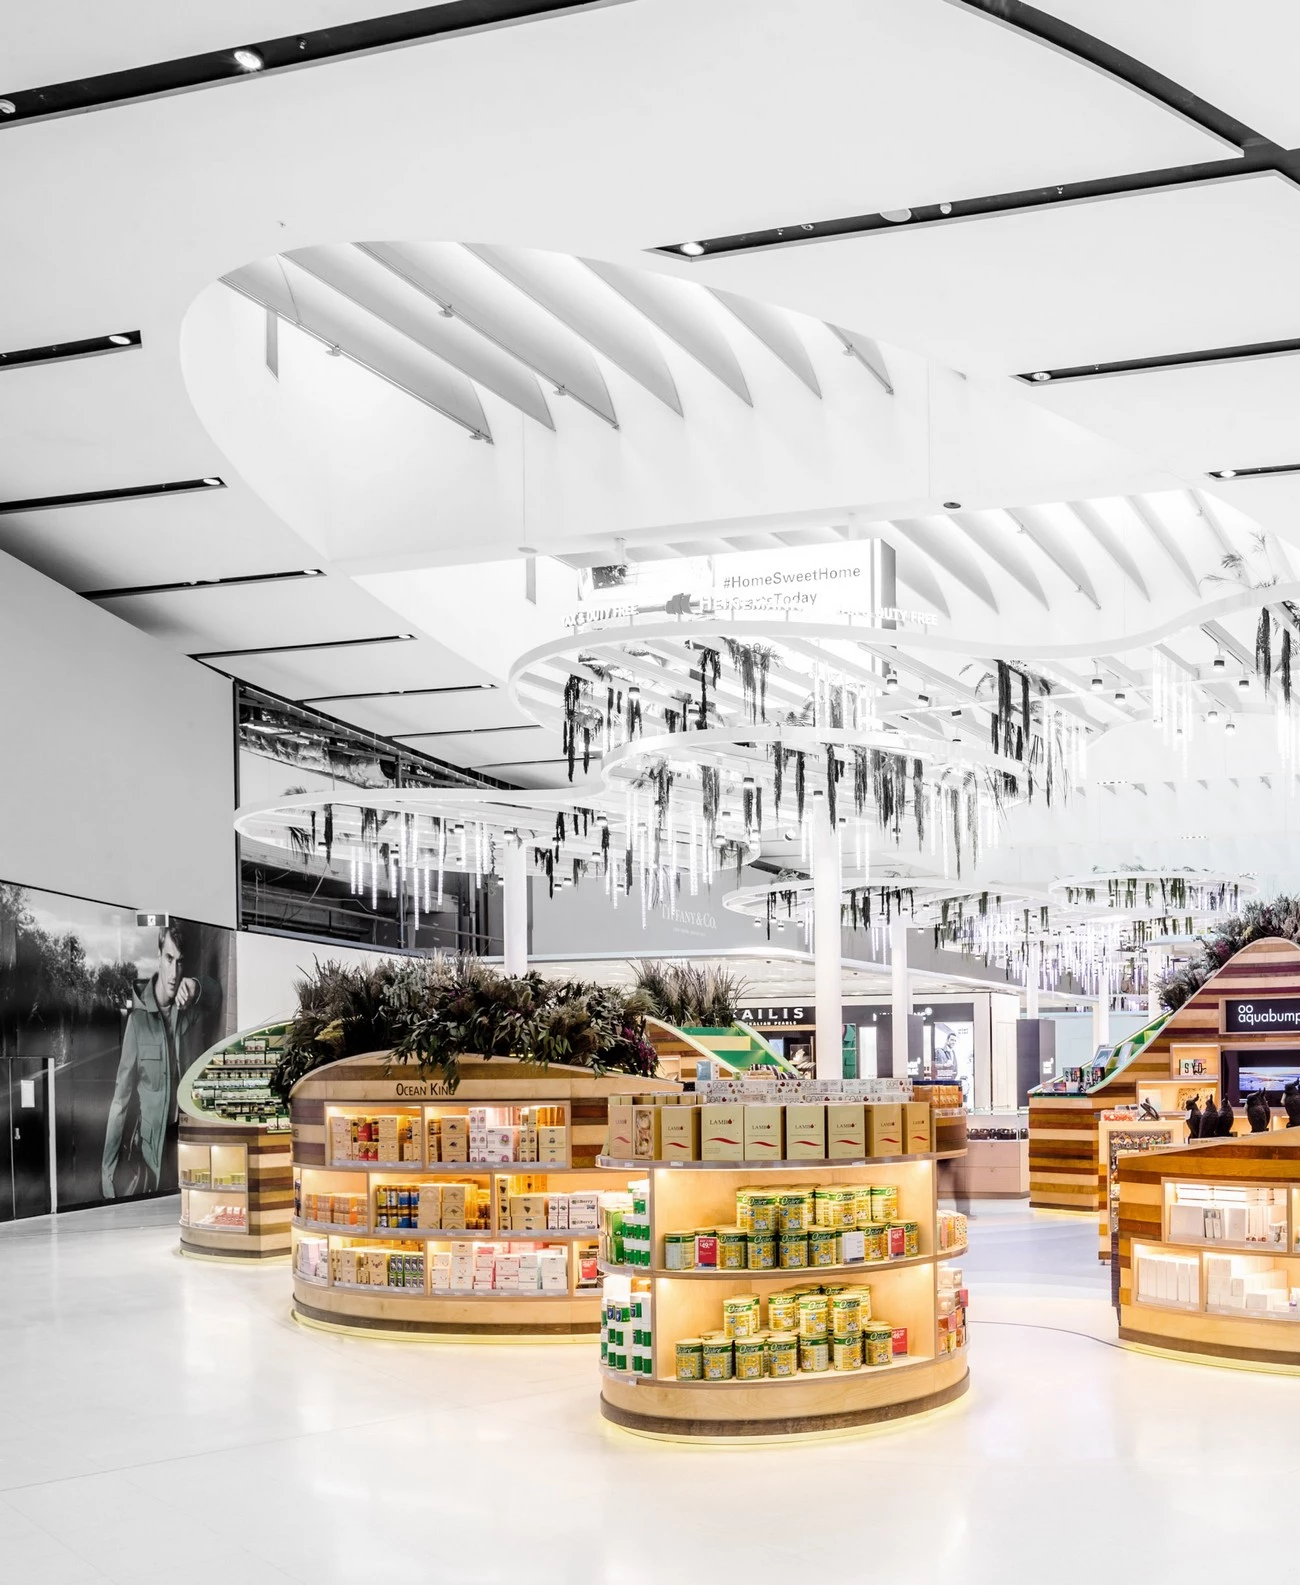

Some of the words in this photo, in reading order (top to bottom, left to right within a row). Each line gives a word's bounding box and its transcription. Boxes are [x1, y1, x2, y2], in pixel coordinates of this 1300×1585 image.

[723, 565, 861, 589] #HomeSweetHome
[614, 604, 640, 618] FREE
[911, 610, 938, 626] FREE
